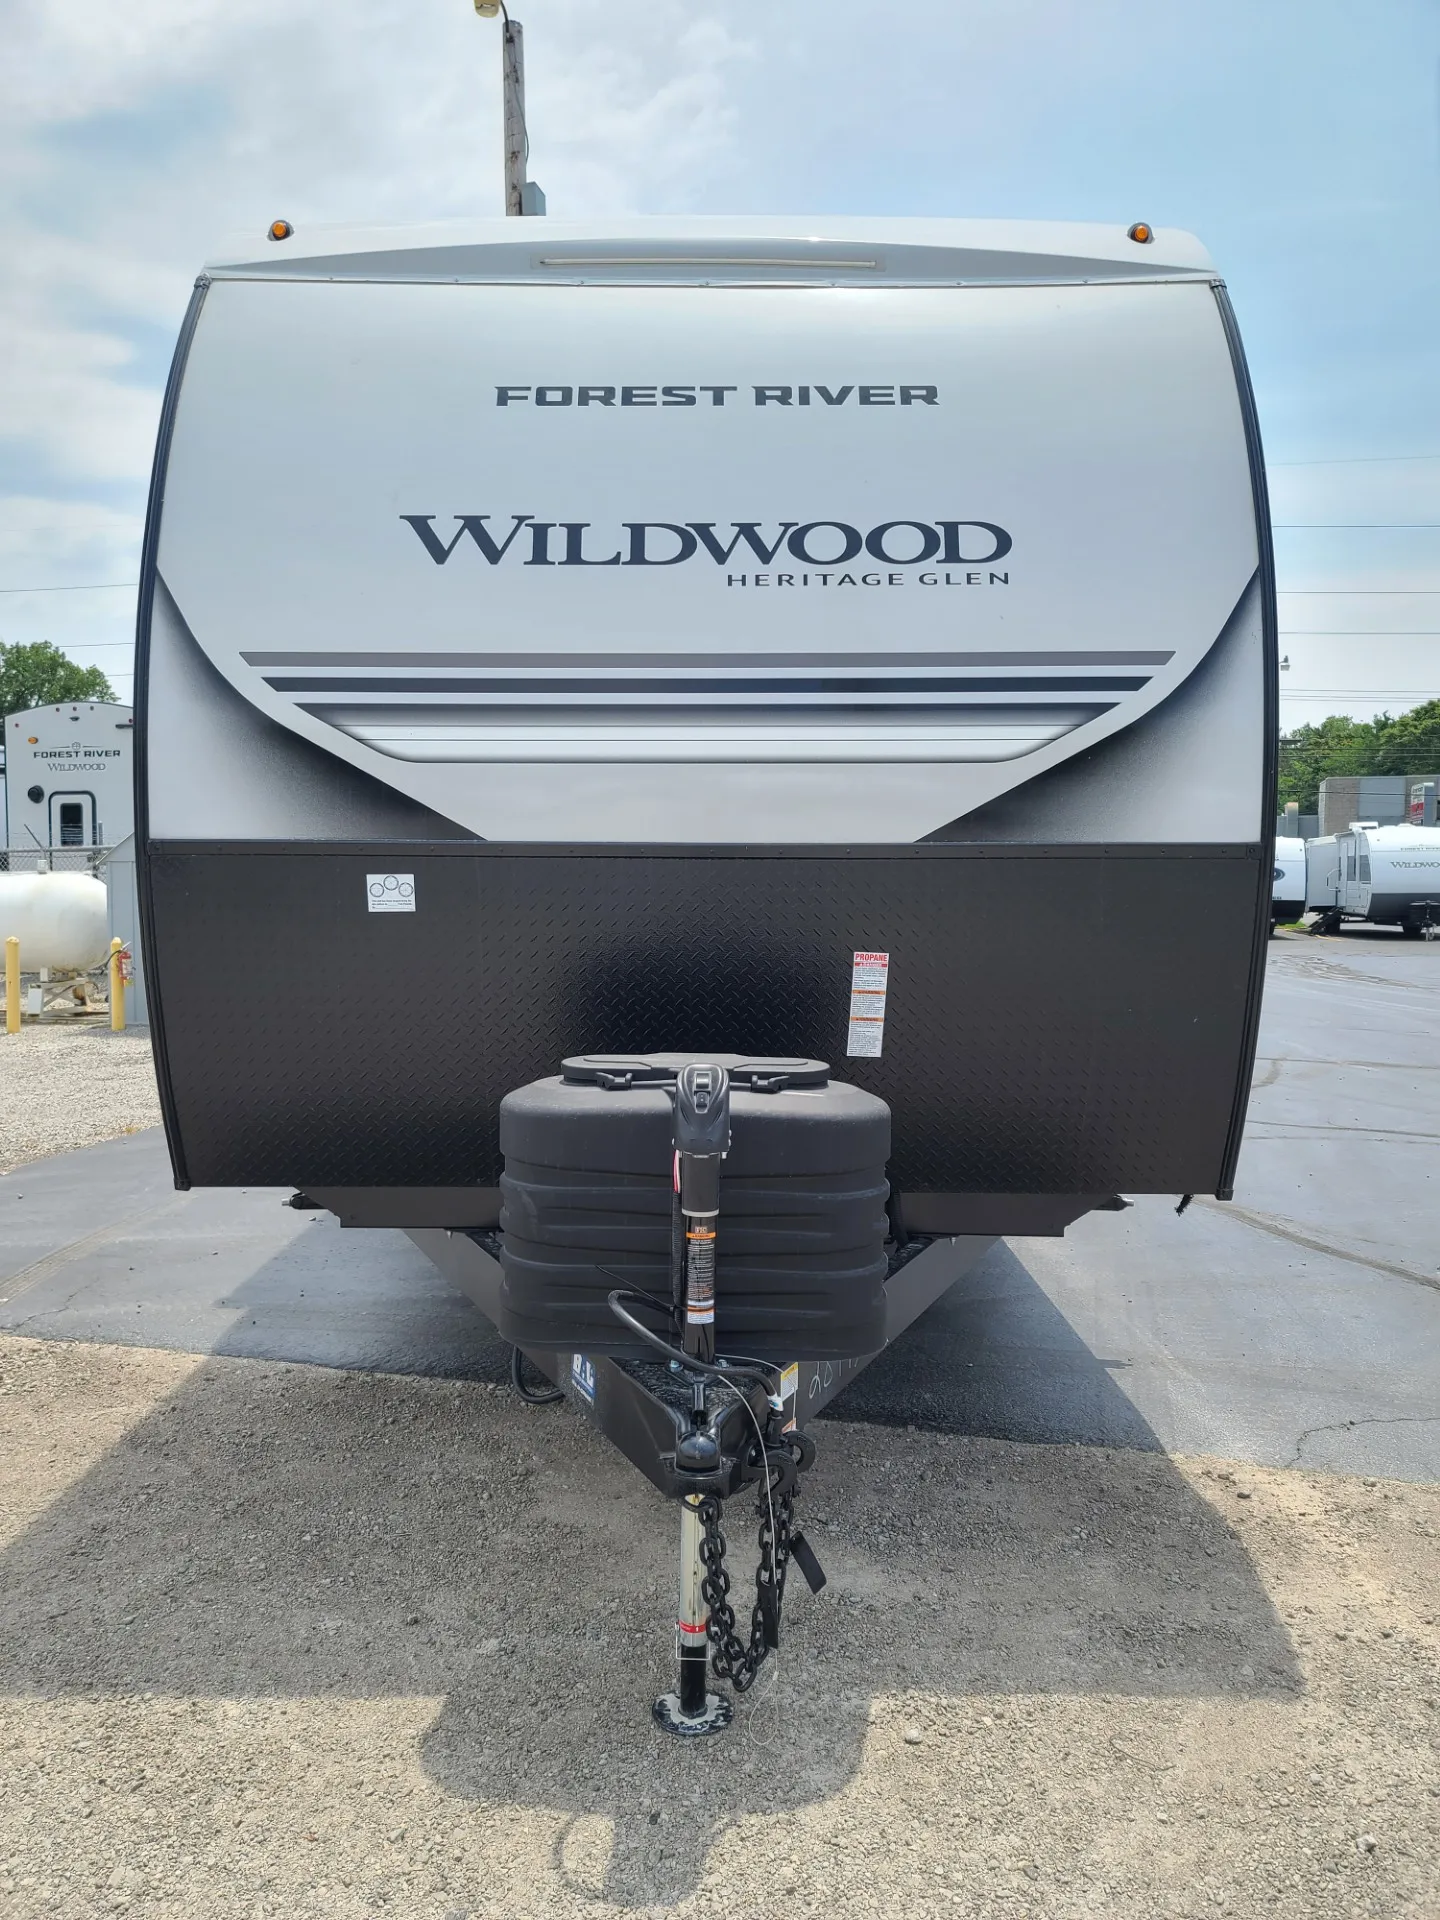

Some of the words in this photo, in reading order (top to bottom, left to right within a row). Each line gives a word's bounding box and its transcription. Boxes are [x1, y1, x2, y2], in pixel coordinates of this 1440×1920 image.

[495, 386, 738, 407] FOREST
[753, 385, 941, 406] RIVER
[399, 514, 1014, 566] WILDWOOD
[727, 573, 905, 588] HERITAGE
[919, 571, 1011, 587] GLEN
[33, 750, 81, 759] FOREST
[84, 749, 121, 757] RIVER
[47, 763, 106, 772] WILDWOOD
[1390, 861, 1440, 869] WILDWO
[855, 953, 887, 962] PROPANE
